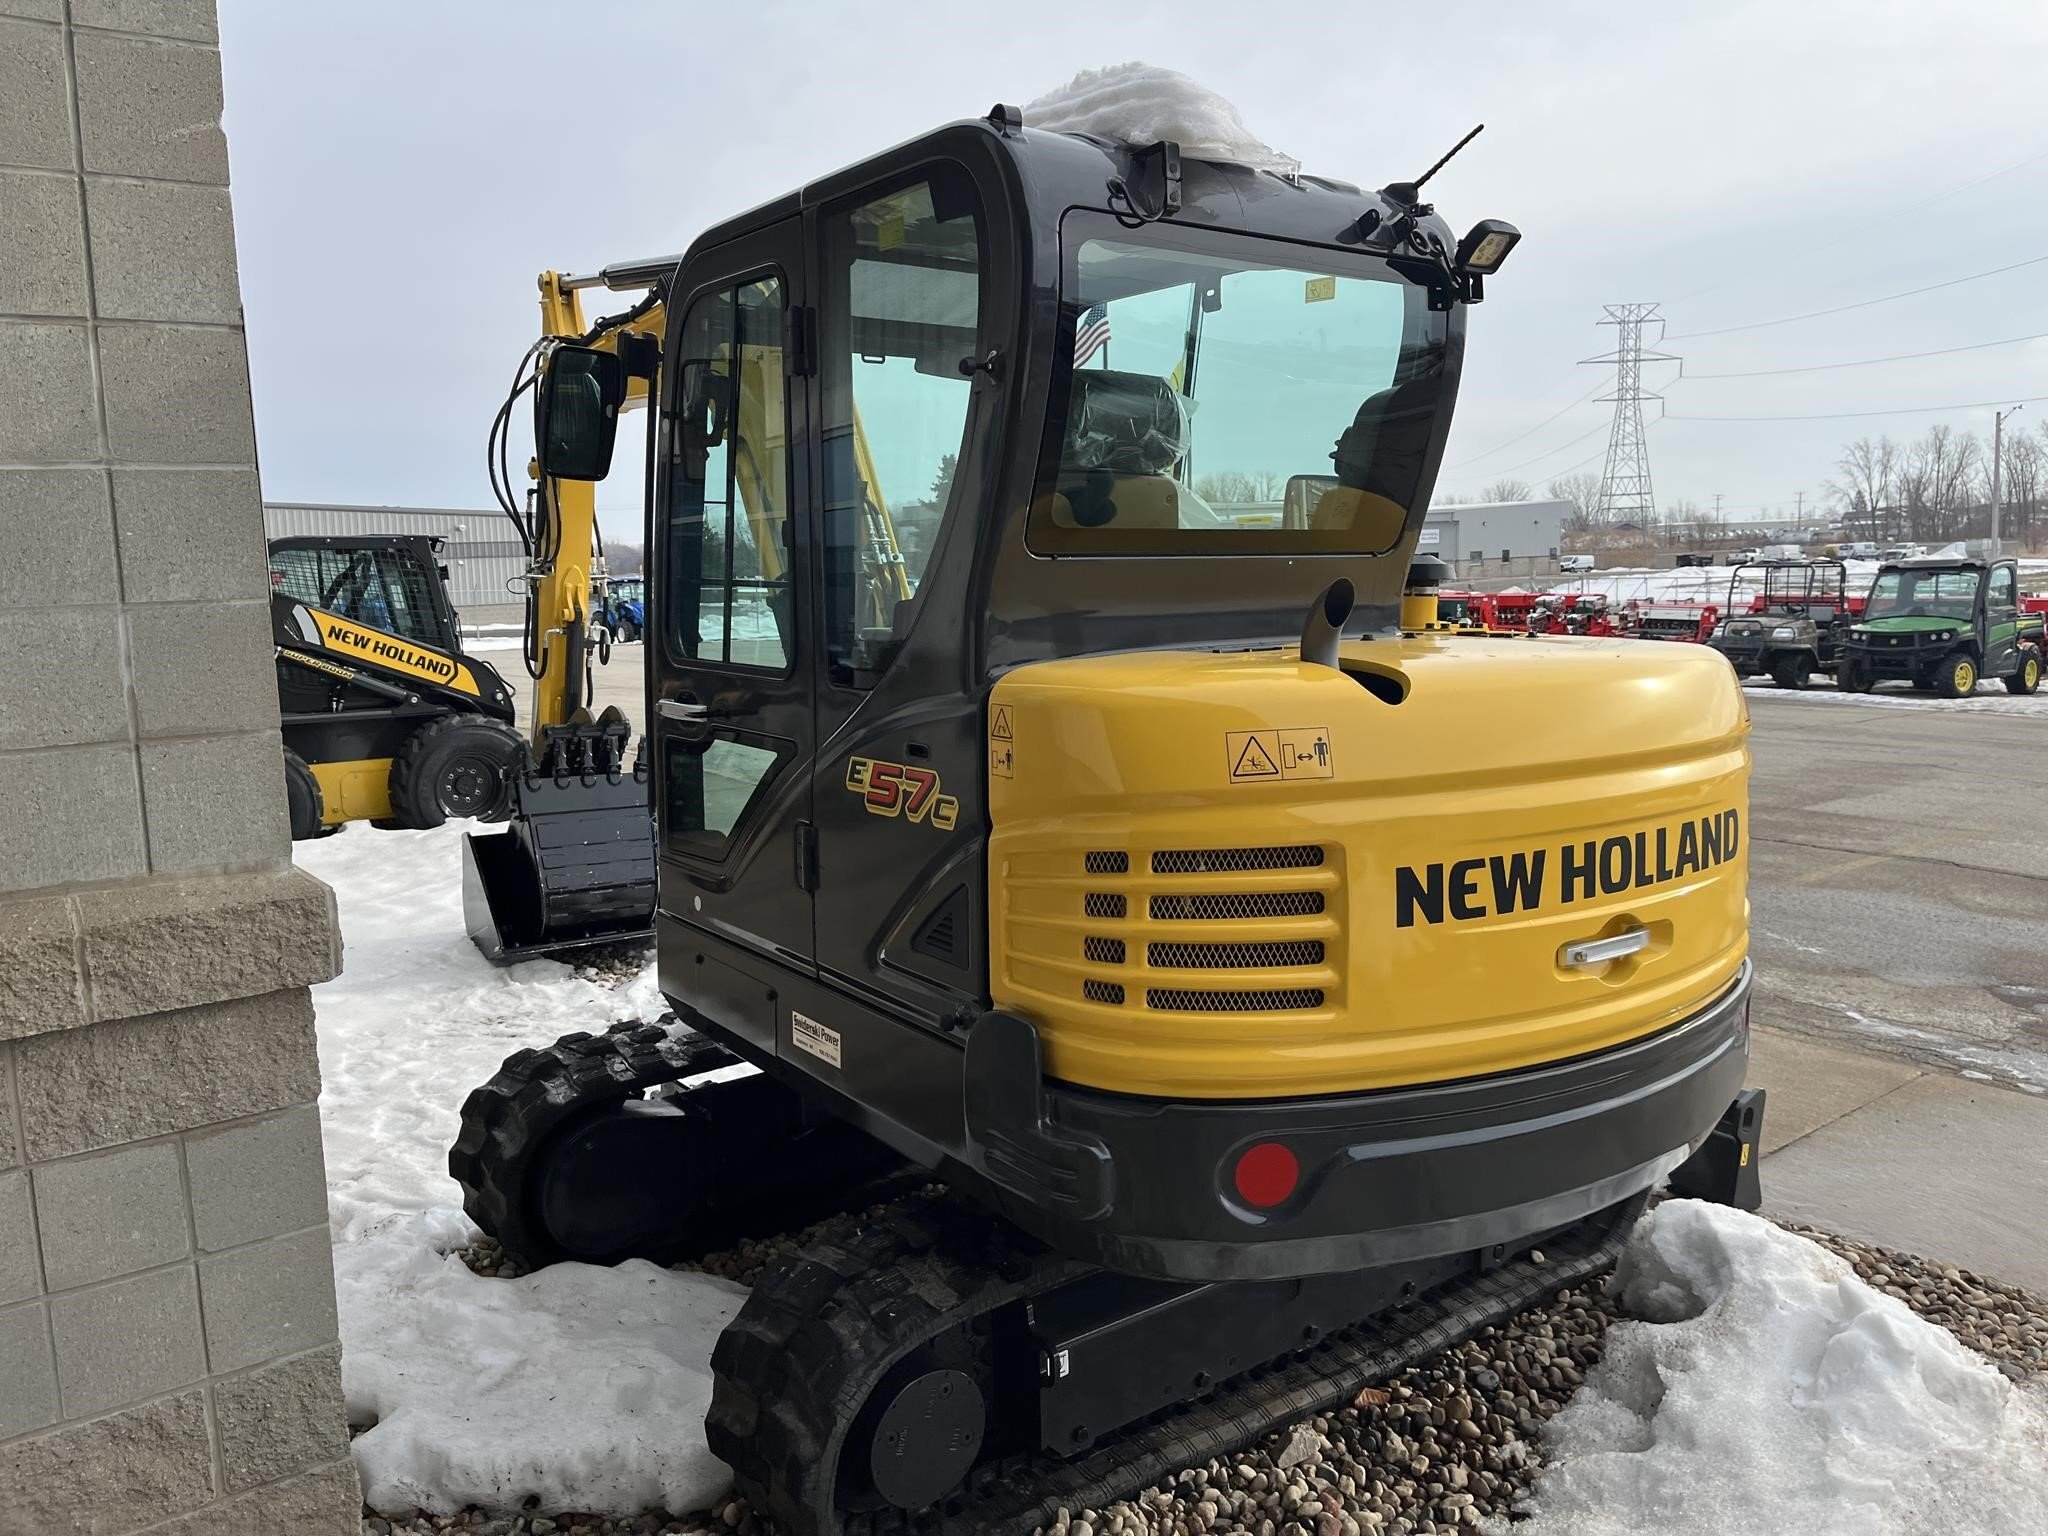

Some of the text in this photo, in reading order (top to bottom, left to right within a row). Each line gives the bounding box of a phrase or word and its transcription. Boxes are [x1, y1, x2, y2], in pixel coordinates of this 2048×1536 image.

[328, 625, 451, 677] NEW HOLLAND
[846, 756, 959, 831] E57C
[1396, 808, 1739, 928] NEW HOLLAND
[821, 1028, 839, 1047] Power
